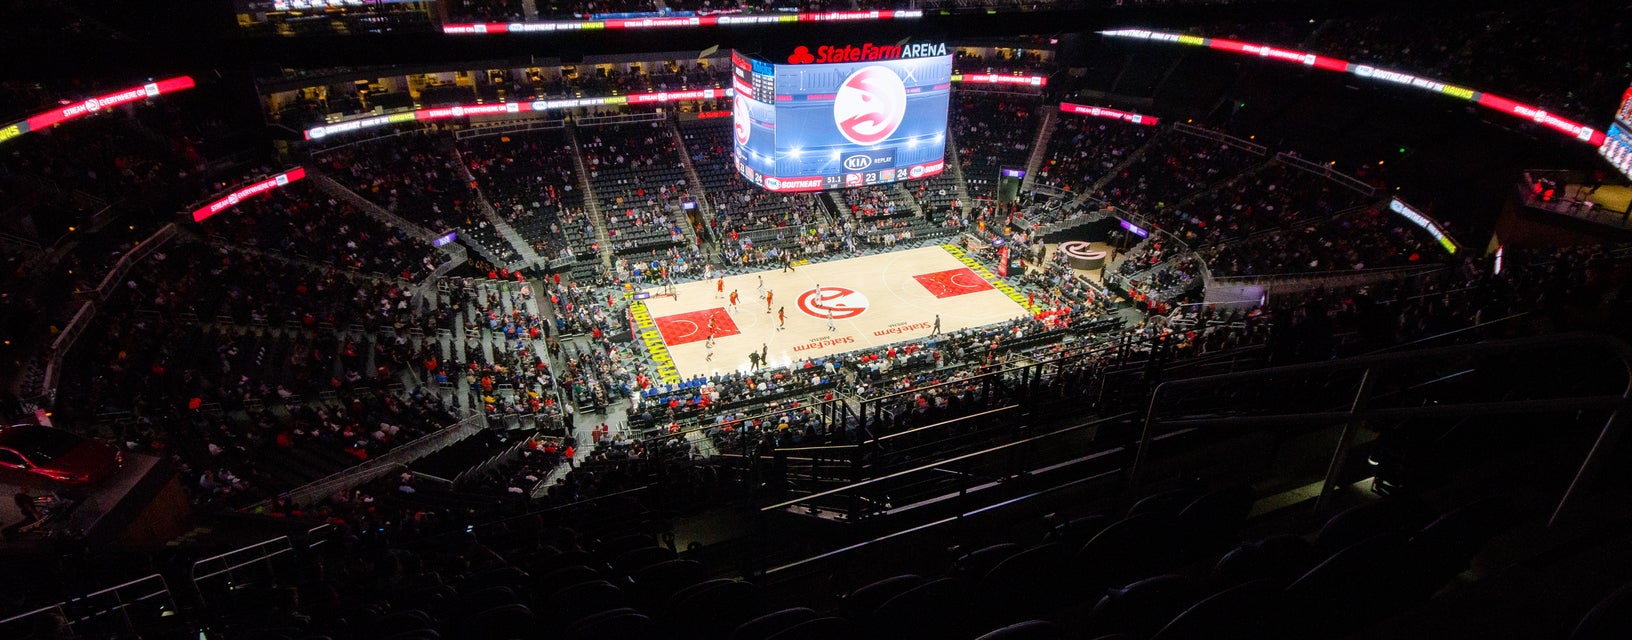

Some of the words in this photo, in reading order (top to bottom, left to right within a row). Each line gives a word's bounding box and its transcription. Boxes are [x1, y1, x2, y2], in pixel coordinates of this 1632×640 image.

[902, 42, 947, 58] ARENA
[1443, 84, 1474, 100] HAWKS
[63, 105, 86, 117] STREAM
[99, 90, 138, 106] EVERYWHERE
[137, 89, 146, 97] ON
[849, 157, 867, 167] KIA
[866, 173, 876, 182] 23
[897, 168, 907, 178] 24
[781, 179, 822, 189] SOUTHEAST
